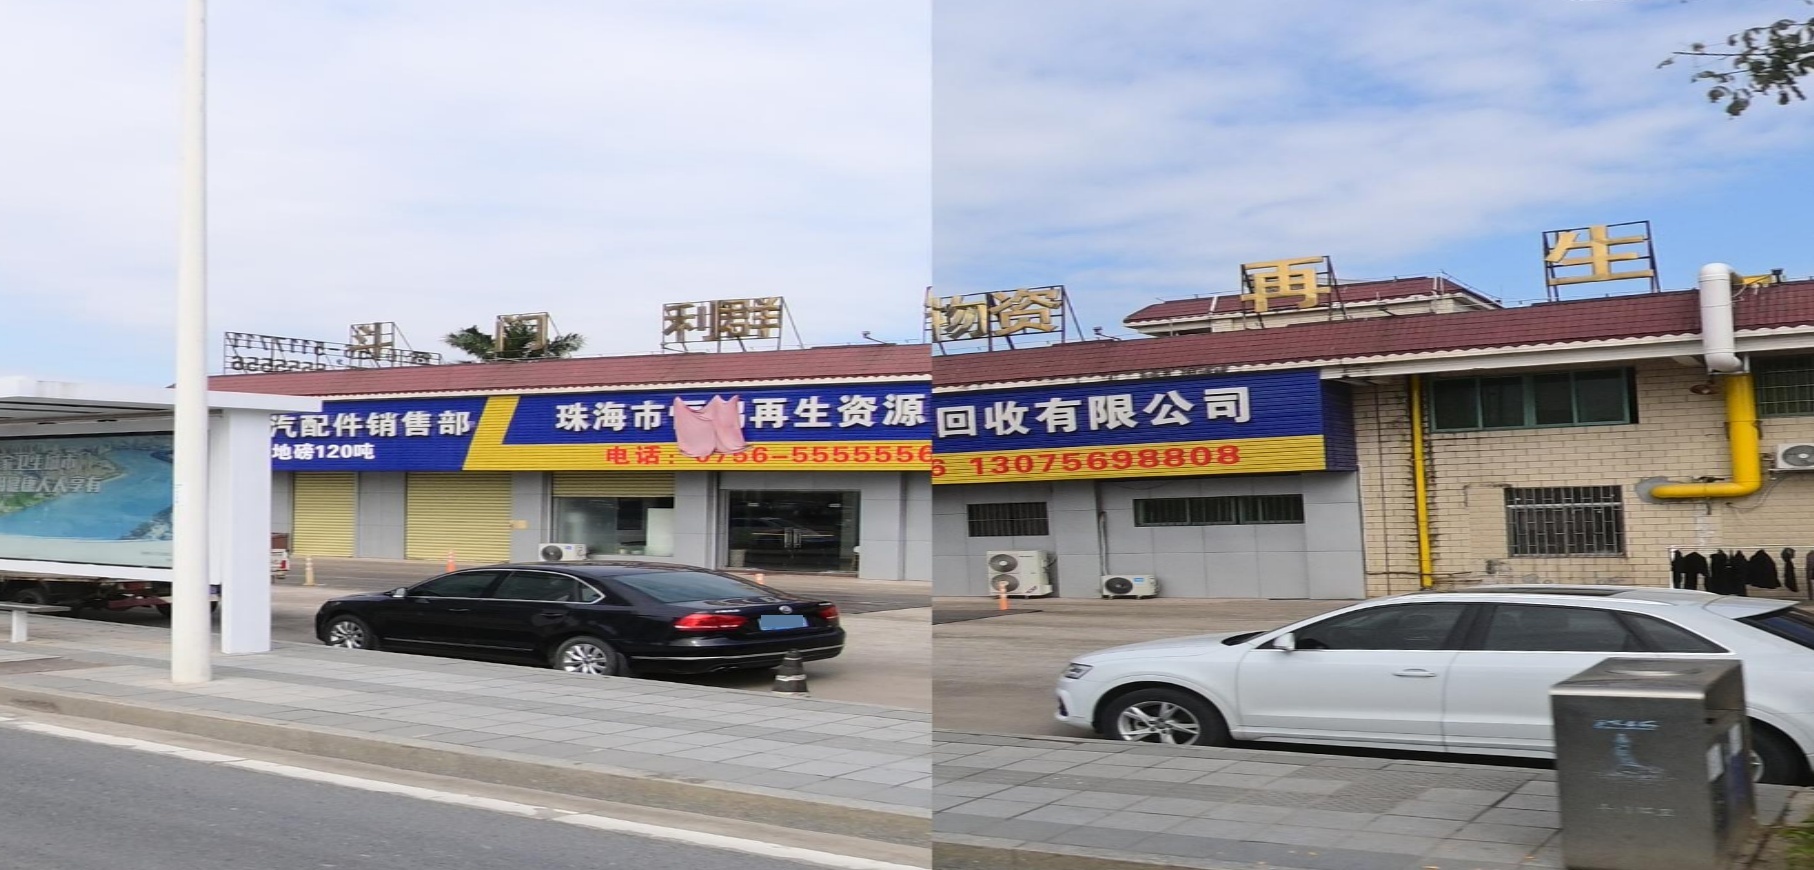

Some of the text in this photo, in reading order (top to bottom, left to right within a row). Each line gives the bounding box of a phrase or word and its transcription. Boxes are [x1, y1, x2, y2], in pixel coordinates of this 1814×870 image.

[663, 297, 781, 341] 利群
[926, 287, 1061, 342] 物资
[1241, 256, 1331, 312] 再
[1545, 225, 1654, 286] 生
[270, 411, 470, 437] 汽配件销售部
[271, 443, 375, 460] 地磅120吨
[969, 445, 1241, 475] 13075698808
